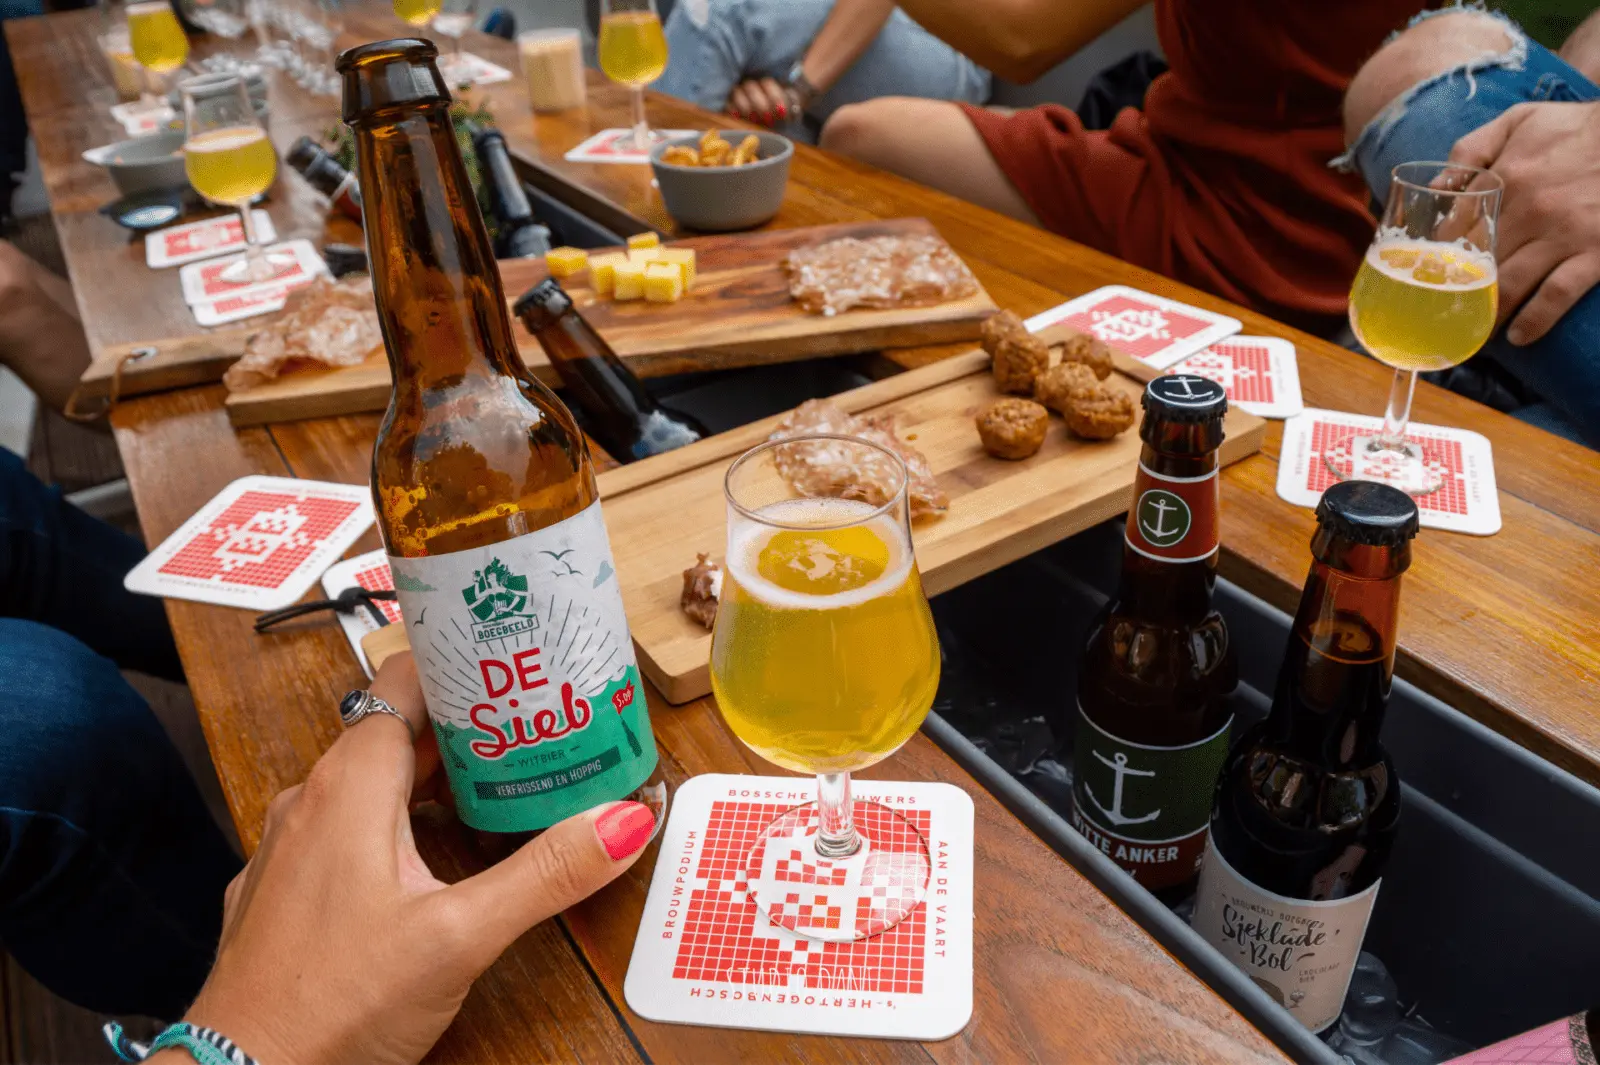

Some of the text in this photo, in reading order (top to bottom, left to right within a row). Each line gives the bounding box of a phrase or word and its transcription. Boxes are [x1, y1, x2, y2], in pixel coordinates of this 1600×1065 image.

[478, 647, 549, 700] DE
[469, 681, 592, 760] Sieb
[516, 749, 566, 768] WITBIER
[496, 759, 602, 796] VERFRISSEND EN HOPPIG
[728, 789, 917, 804] BOSSCHE UWERS
[1115, 845, 1179, 864] ANKER
[662, 831, 697, 938] BROUWPODIUM
[934, 840, 949, 958] AAN DE VAART
[1250, 941, 1293, 971] Bol
